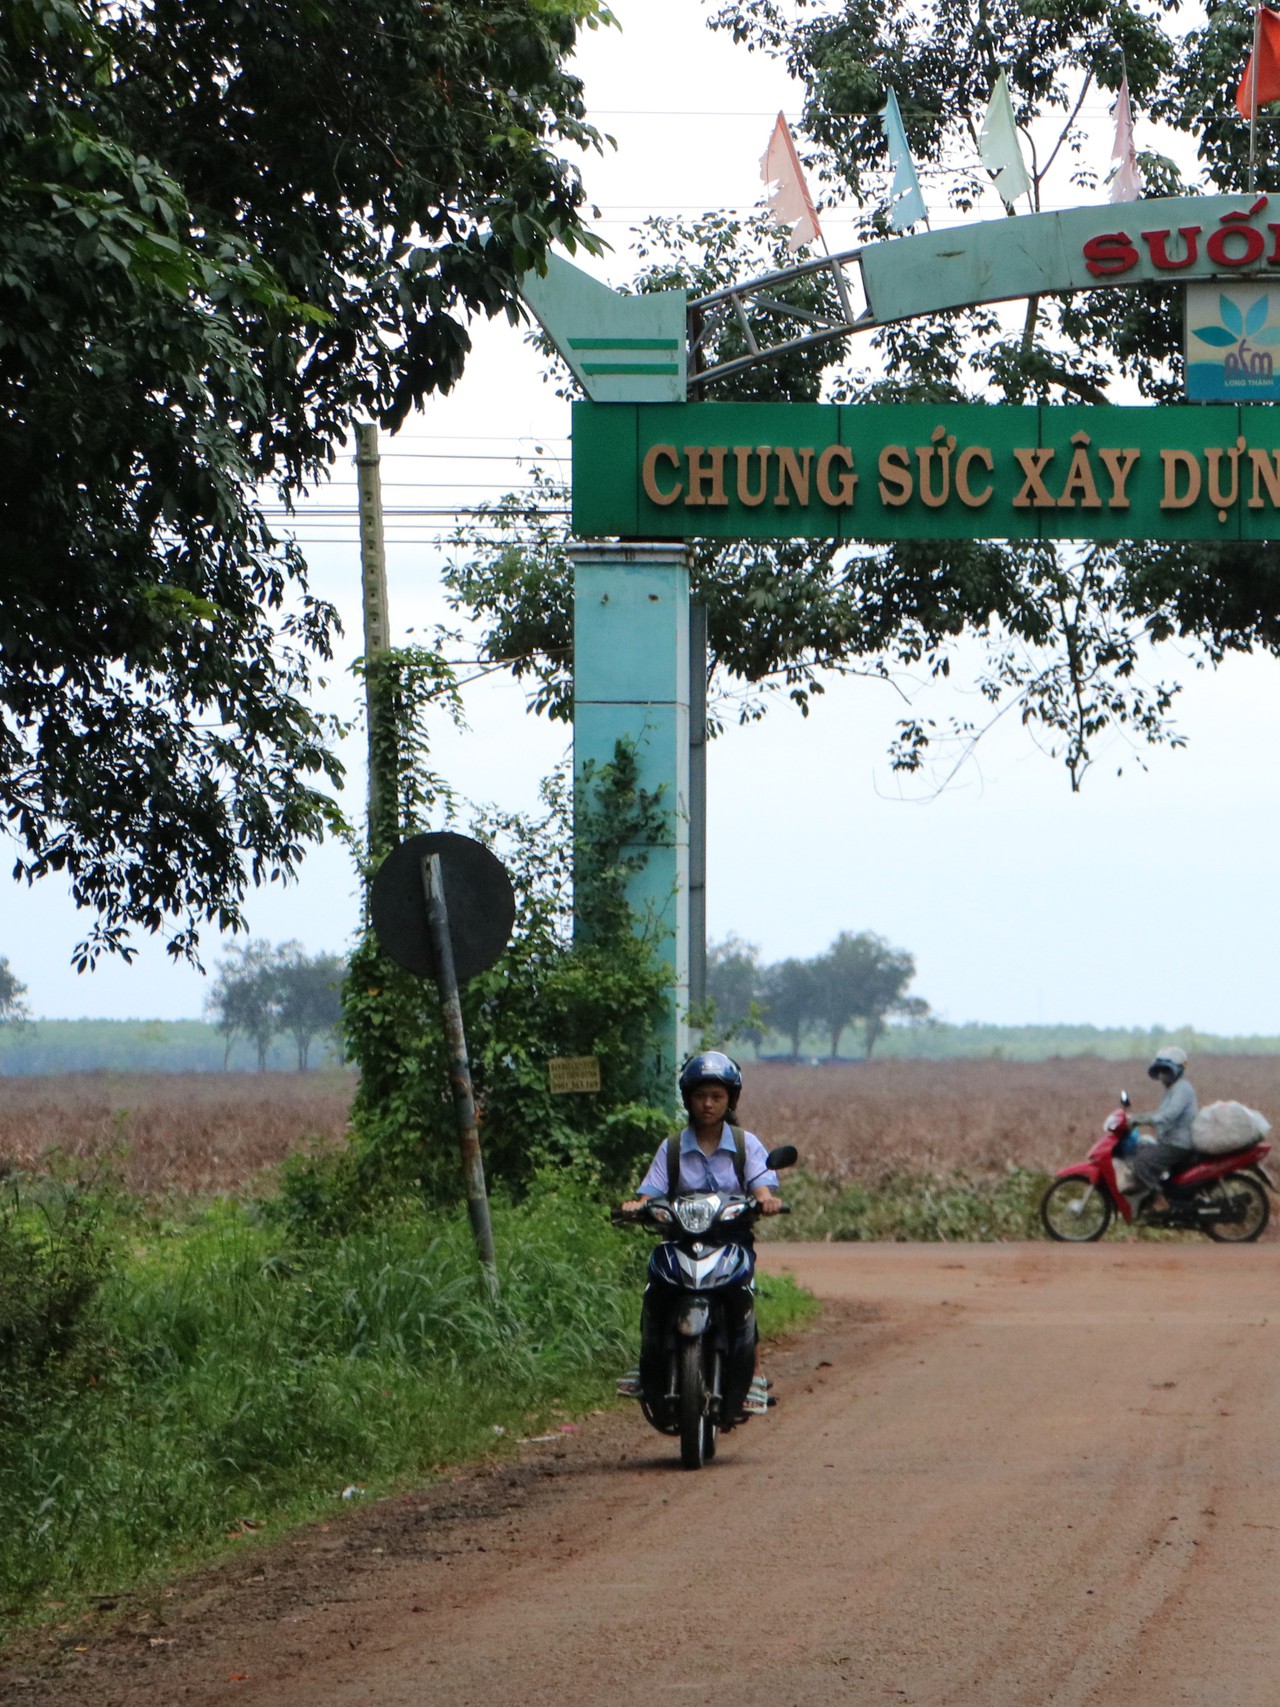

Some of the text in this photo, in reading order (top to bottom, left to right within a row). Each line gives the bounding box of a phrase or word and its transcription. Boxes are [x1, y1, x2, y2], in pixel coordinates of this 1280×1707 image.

[1225, 379, 1246, 387] LONG
[642, 444, 858, 506] CHUNG
[878, 425, 994, 507] SỨC
[1012, 430, 1140, 508] XÂY
